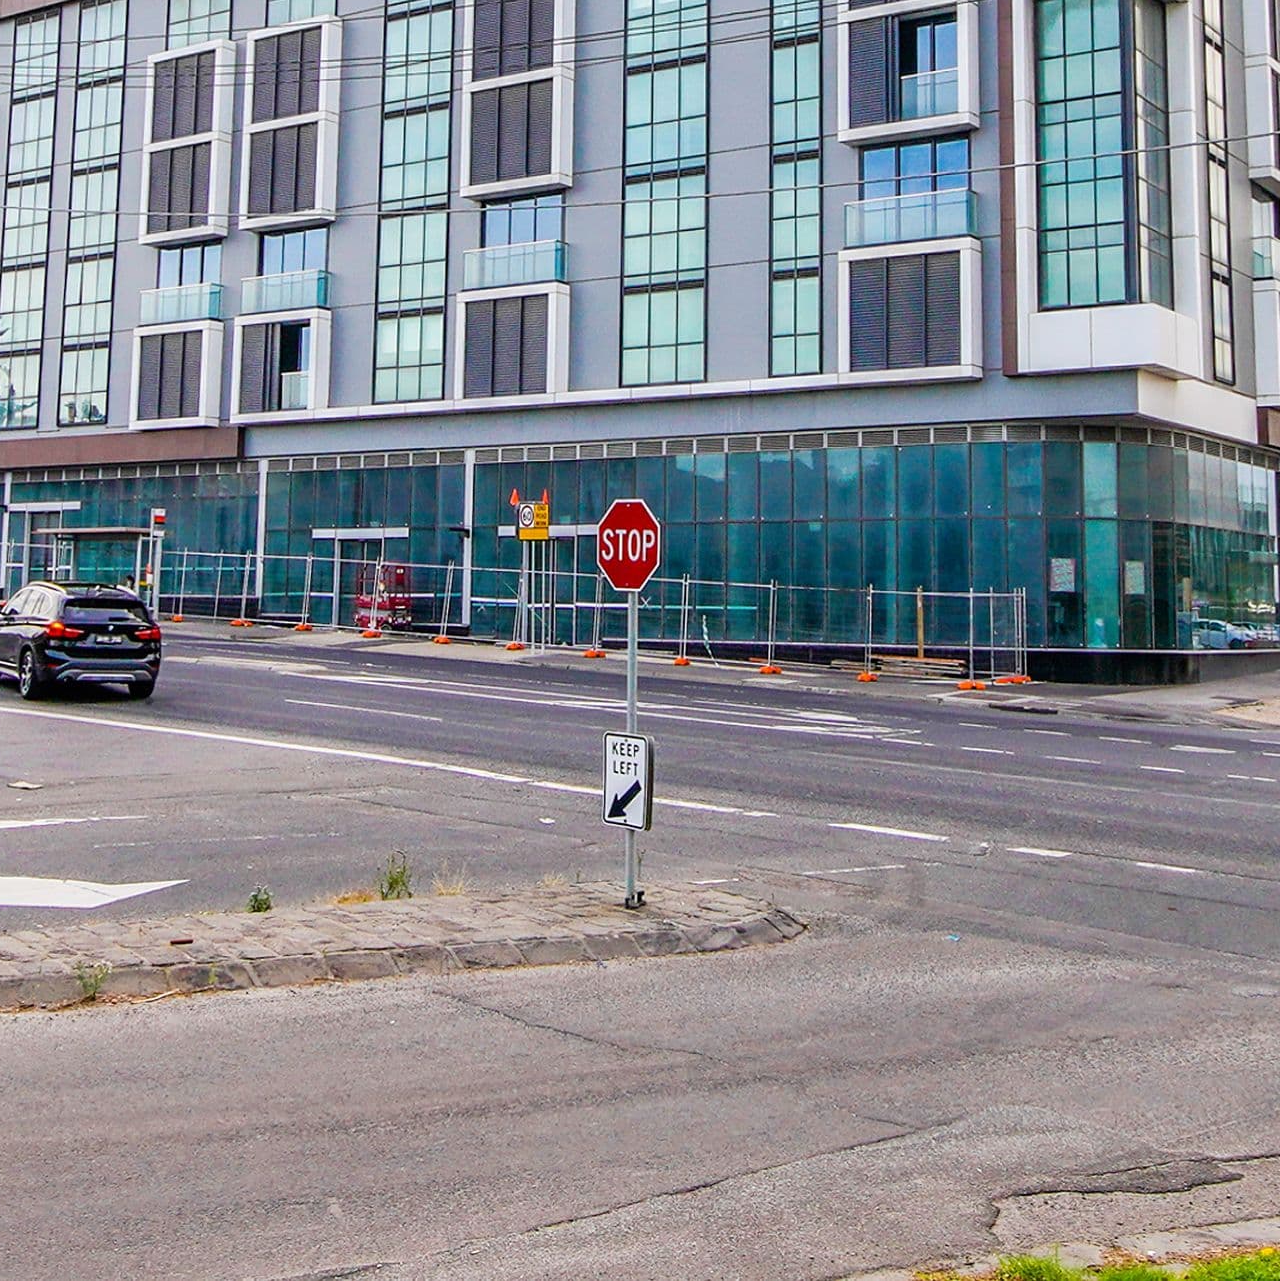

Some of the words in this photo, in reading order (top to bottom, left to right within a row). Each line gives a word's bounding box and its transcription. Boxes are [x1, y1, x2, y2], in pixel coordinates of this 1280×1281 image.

[601, 529, 656, 562] STOP
[611, 742, 640, 758] KEEP
[613, 761, 638, 776] LEFT
